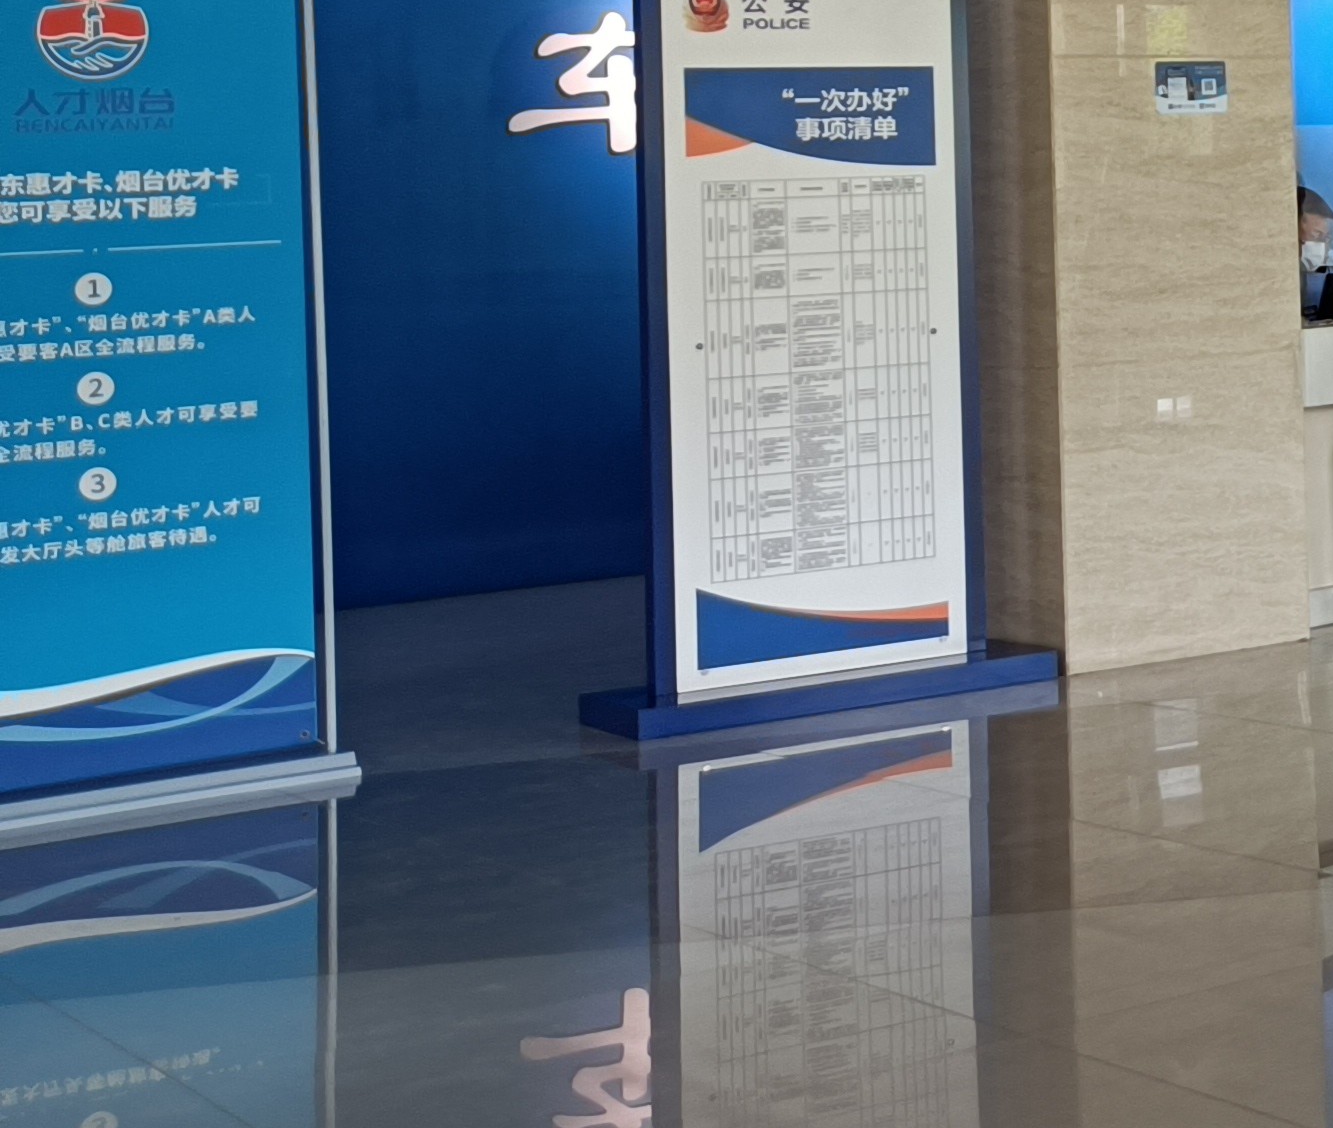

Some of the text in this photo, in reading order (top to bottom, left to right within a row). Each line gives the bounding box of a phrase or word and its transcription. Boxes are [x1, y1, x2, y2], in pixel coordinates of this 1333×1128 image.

[743, 17, 810, 30] POLICE
[14, 86, 176, 117] 人才烟台
[781, 86, 910, 113] “一次办好”
[795, 115, 899, 142] 事项清单
[0, 195, 198, 224] 您可享受以下服务
